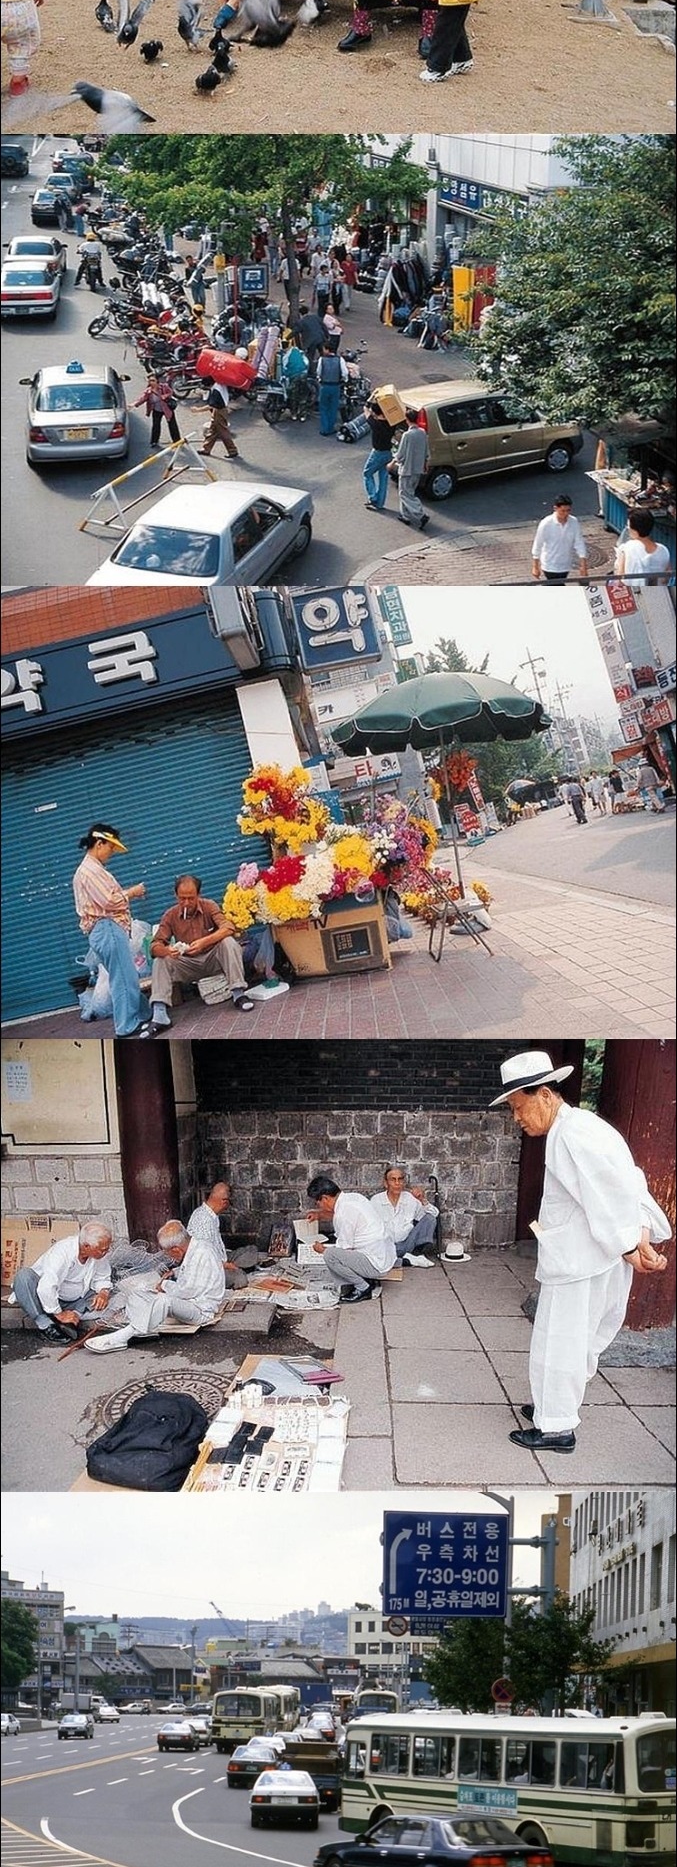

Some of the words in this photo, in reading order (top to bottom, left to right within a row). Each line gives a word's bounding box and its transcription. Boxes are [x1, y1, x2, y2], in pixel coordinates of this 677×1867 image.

[301, 588, 369, 653] 약
[310, 915, 329, 930] TV
[416, 1568, 499, 1585] 7:30-9:00
[414, 1591, 500, 1609] 일,공휴일제외
